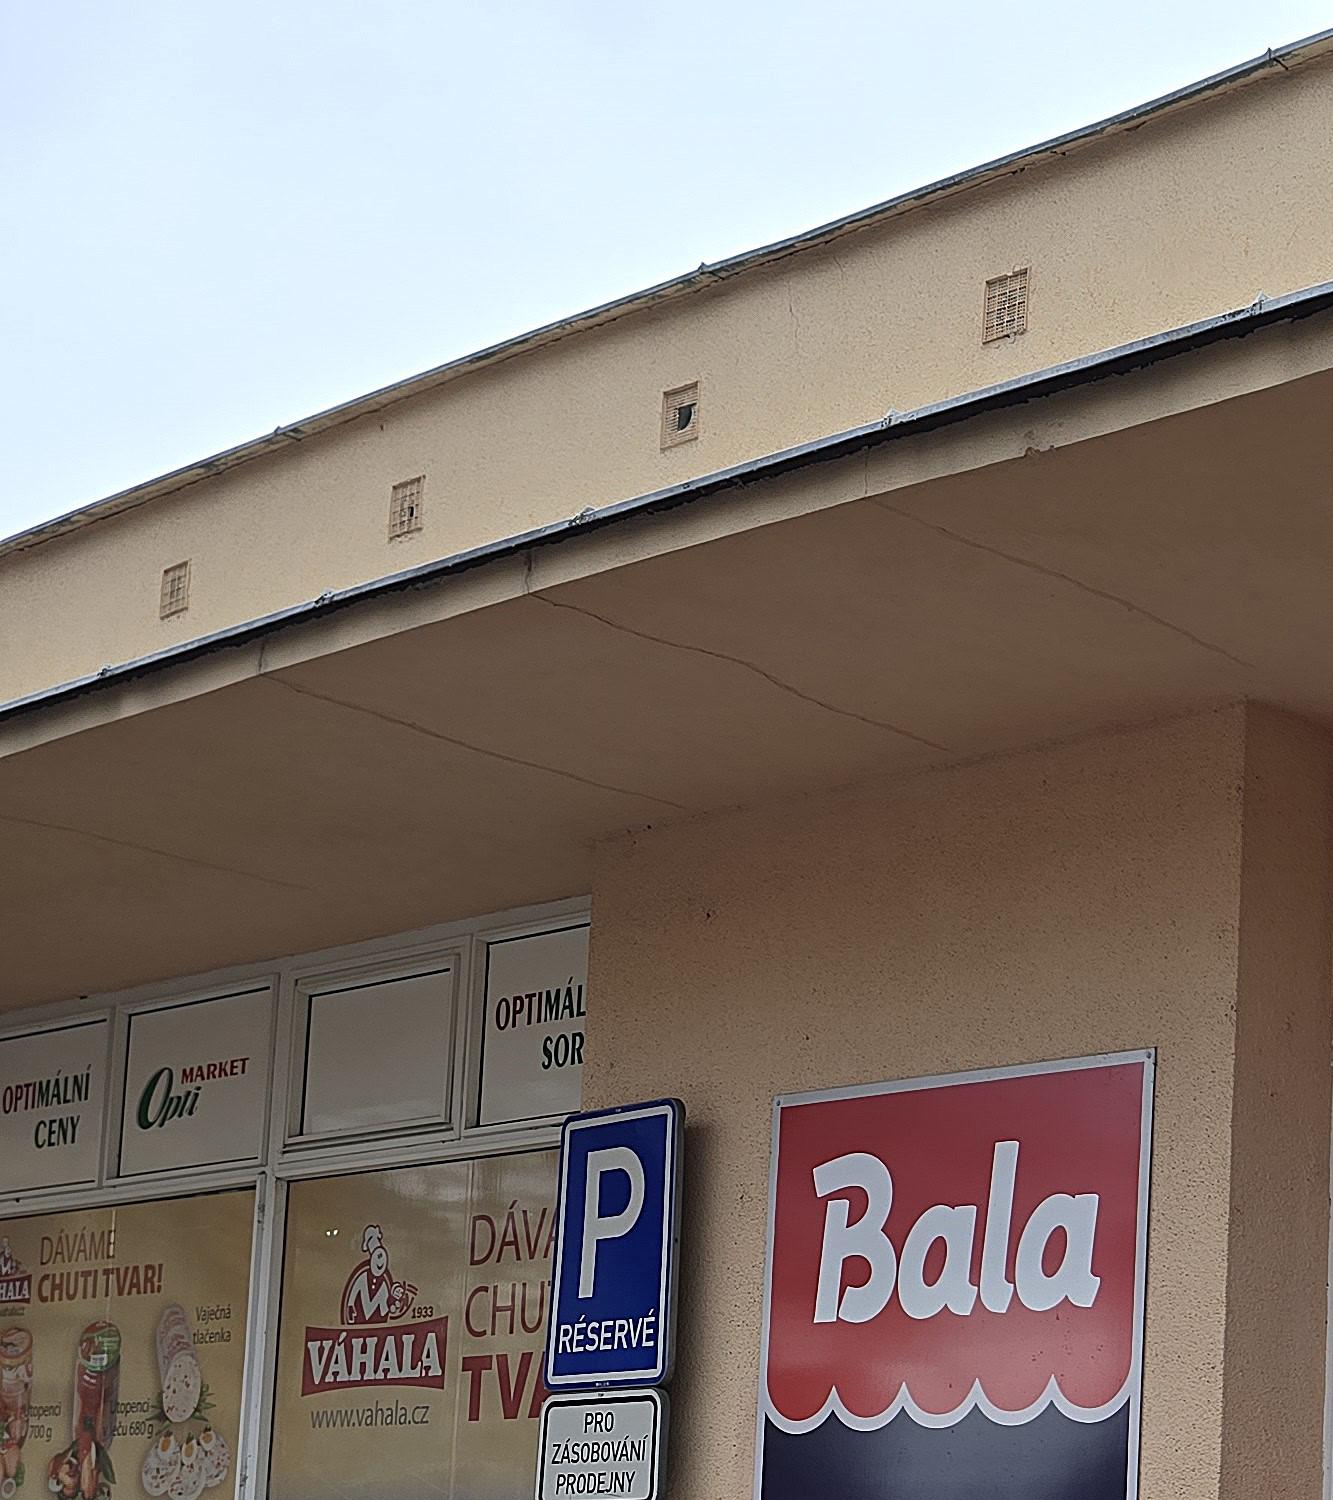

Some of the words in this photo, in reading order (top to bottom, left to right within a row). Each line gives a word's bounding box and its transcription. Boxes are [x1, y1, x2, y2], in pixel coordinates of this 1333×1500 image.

[2, 1064, 91, 1115] OPTIMÁLNÍ
[181, 1057, 249, 1085] MARKET
[136, 1067, 202, 1130] Opti
[34, 1115, 80, 1149] CENY
[577, 1146, 645, 1299] P
[812, 1140, 1101, 1324] Bala
[40, 1226, 117, 1266] DÁVÁME
[38, 1269, 98, 1303] CHUTI
[102, 1264, 163, 1298] TVAR!
[411, 1306, 434, 1319] 1933
[465, 1281, 551, 1338] CHU
[558, 1309, 655, 1354] RÉSERVÉ
[307, 1332, 442, 1385] VÁHALA
[311, 1400, 430, 1429] www.vahala.cz
[584, 1412, 614, 1433] PRO
[551, 1435, 648, 1465] ZÁSOBOVÁNÍ
[556, 1471, 635, 1496] PRODEJNY
